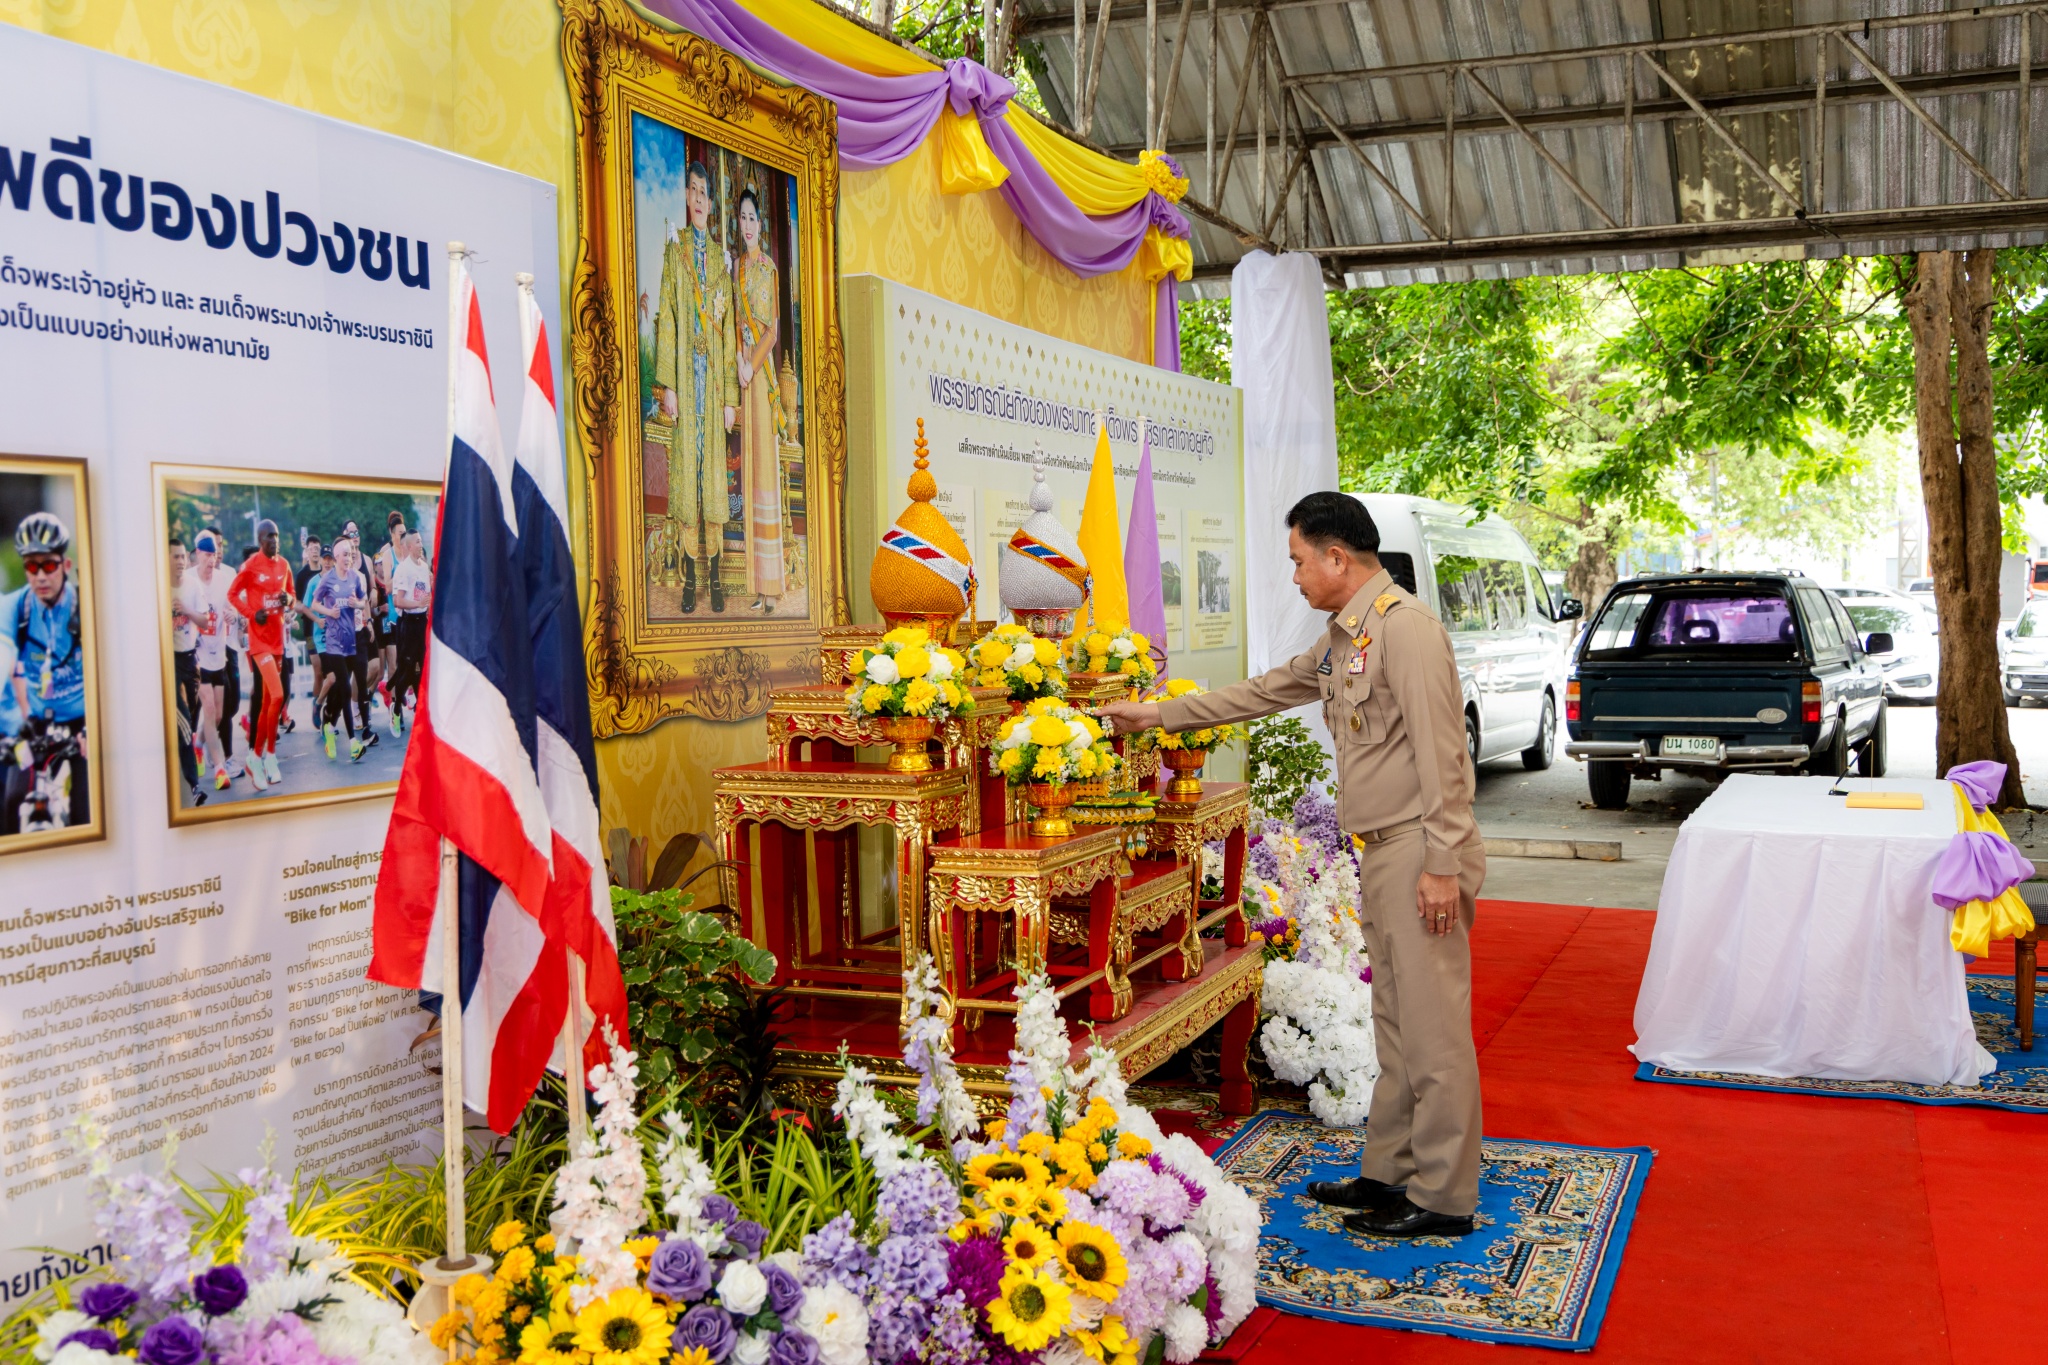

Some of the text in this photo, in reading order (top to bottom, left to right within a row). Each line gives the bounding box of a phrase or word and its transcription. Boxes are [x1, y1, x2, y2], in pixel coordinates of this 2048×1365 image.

[0, 302, 270, 361] งเป็นแบบอย่างแห่งพลานามัย
[162, 290, 194, 310] และ
[200, 294, 433, 349] สมเด็จพระนางเจ้าพระบรมราชินี
[1688, 738, 1715, 750] 1080
[138, 875, 222, 906] พระบรมราชินี
[319, 904, 337, 918] for
[289, 1013, 329, 1031] กิจกรรม
[359, 1000, 374, 1011] for
[375, 993, 399, 1007] Mom
[223, 1027, 274, 1049] ไปทรงร่วม
[314, 1031, 327, 1042] for
[329, 1023, 346, 1036] Dad
[111, 1075, 159, 1103] ไทยแลนด์
[162, 1066, 205, 1087] มาราธอน
[258, 1079, 277, 1096] เพื่อ
